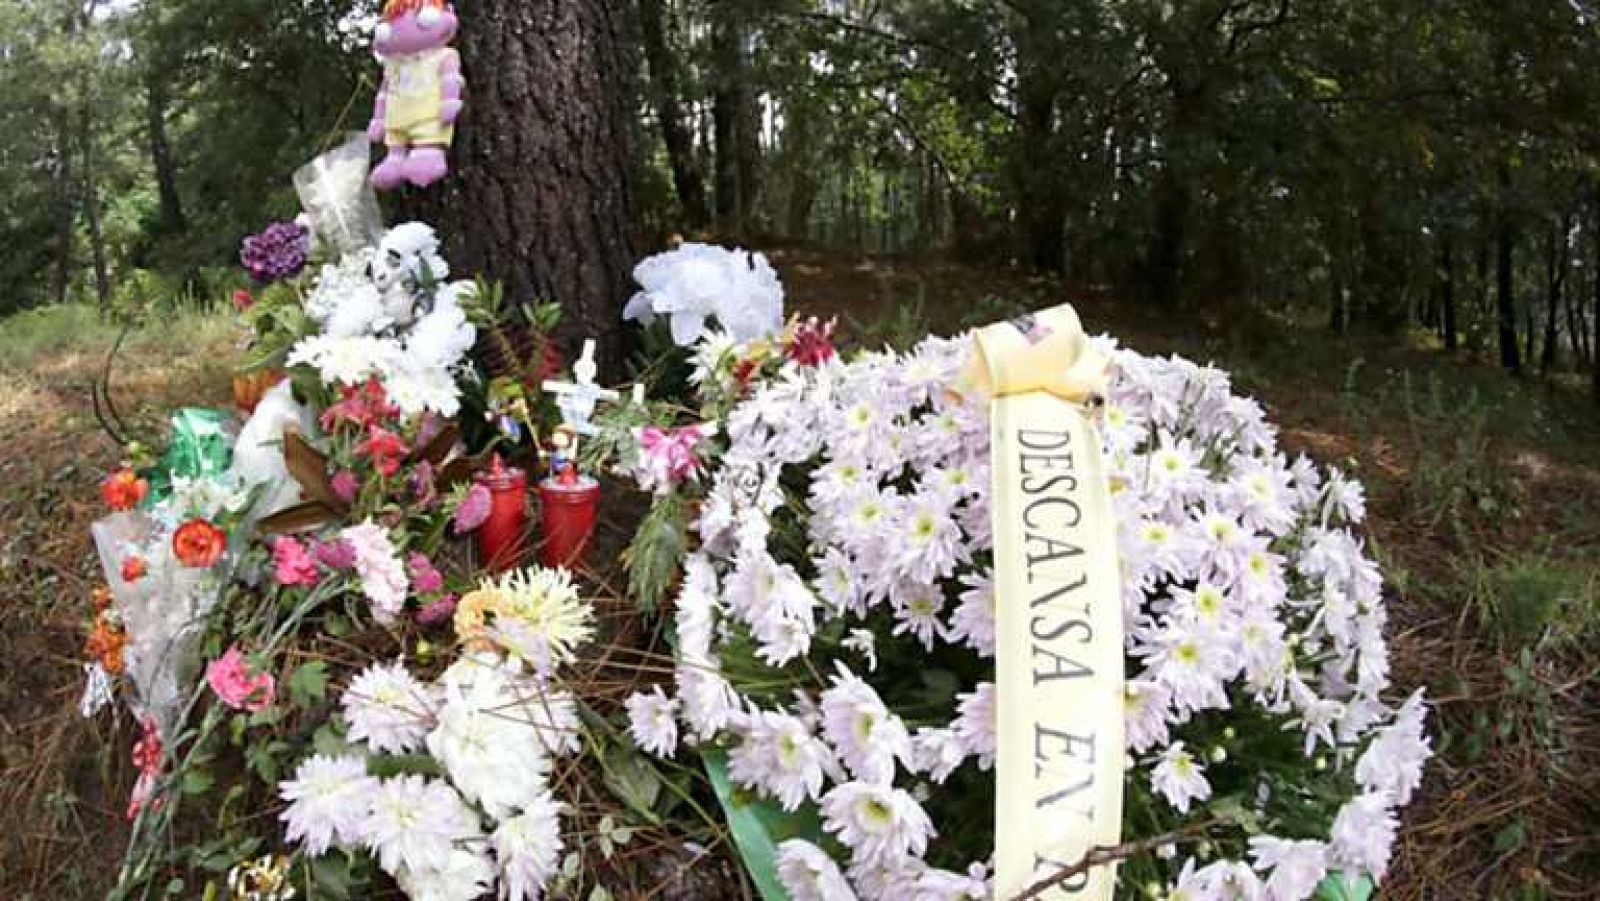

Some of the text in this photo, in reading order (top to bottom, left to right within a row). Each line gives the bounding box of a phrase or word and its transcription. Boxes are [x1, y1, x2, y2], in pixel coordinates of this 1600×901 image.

[1017, 428, 1095, 897] DESCANSA EN P
